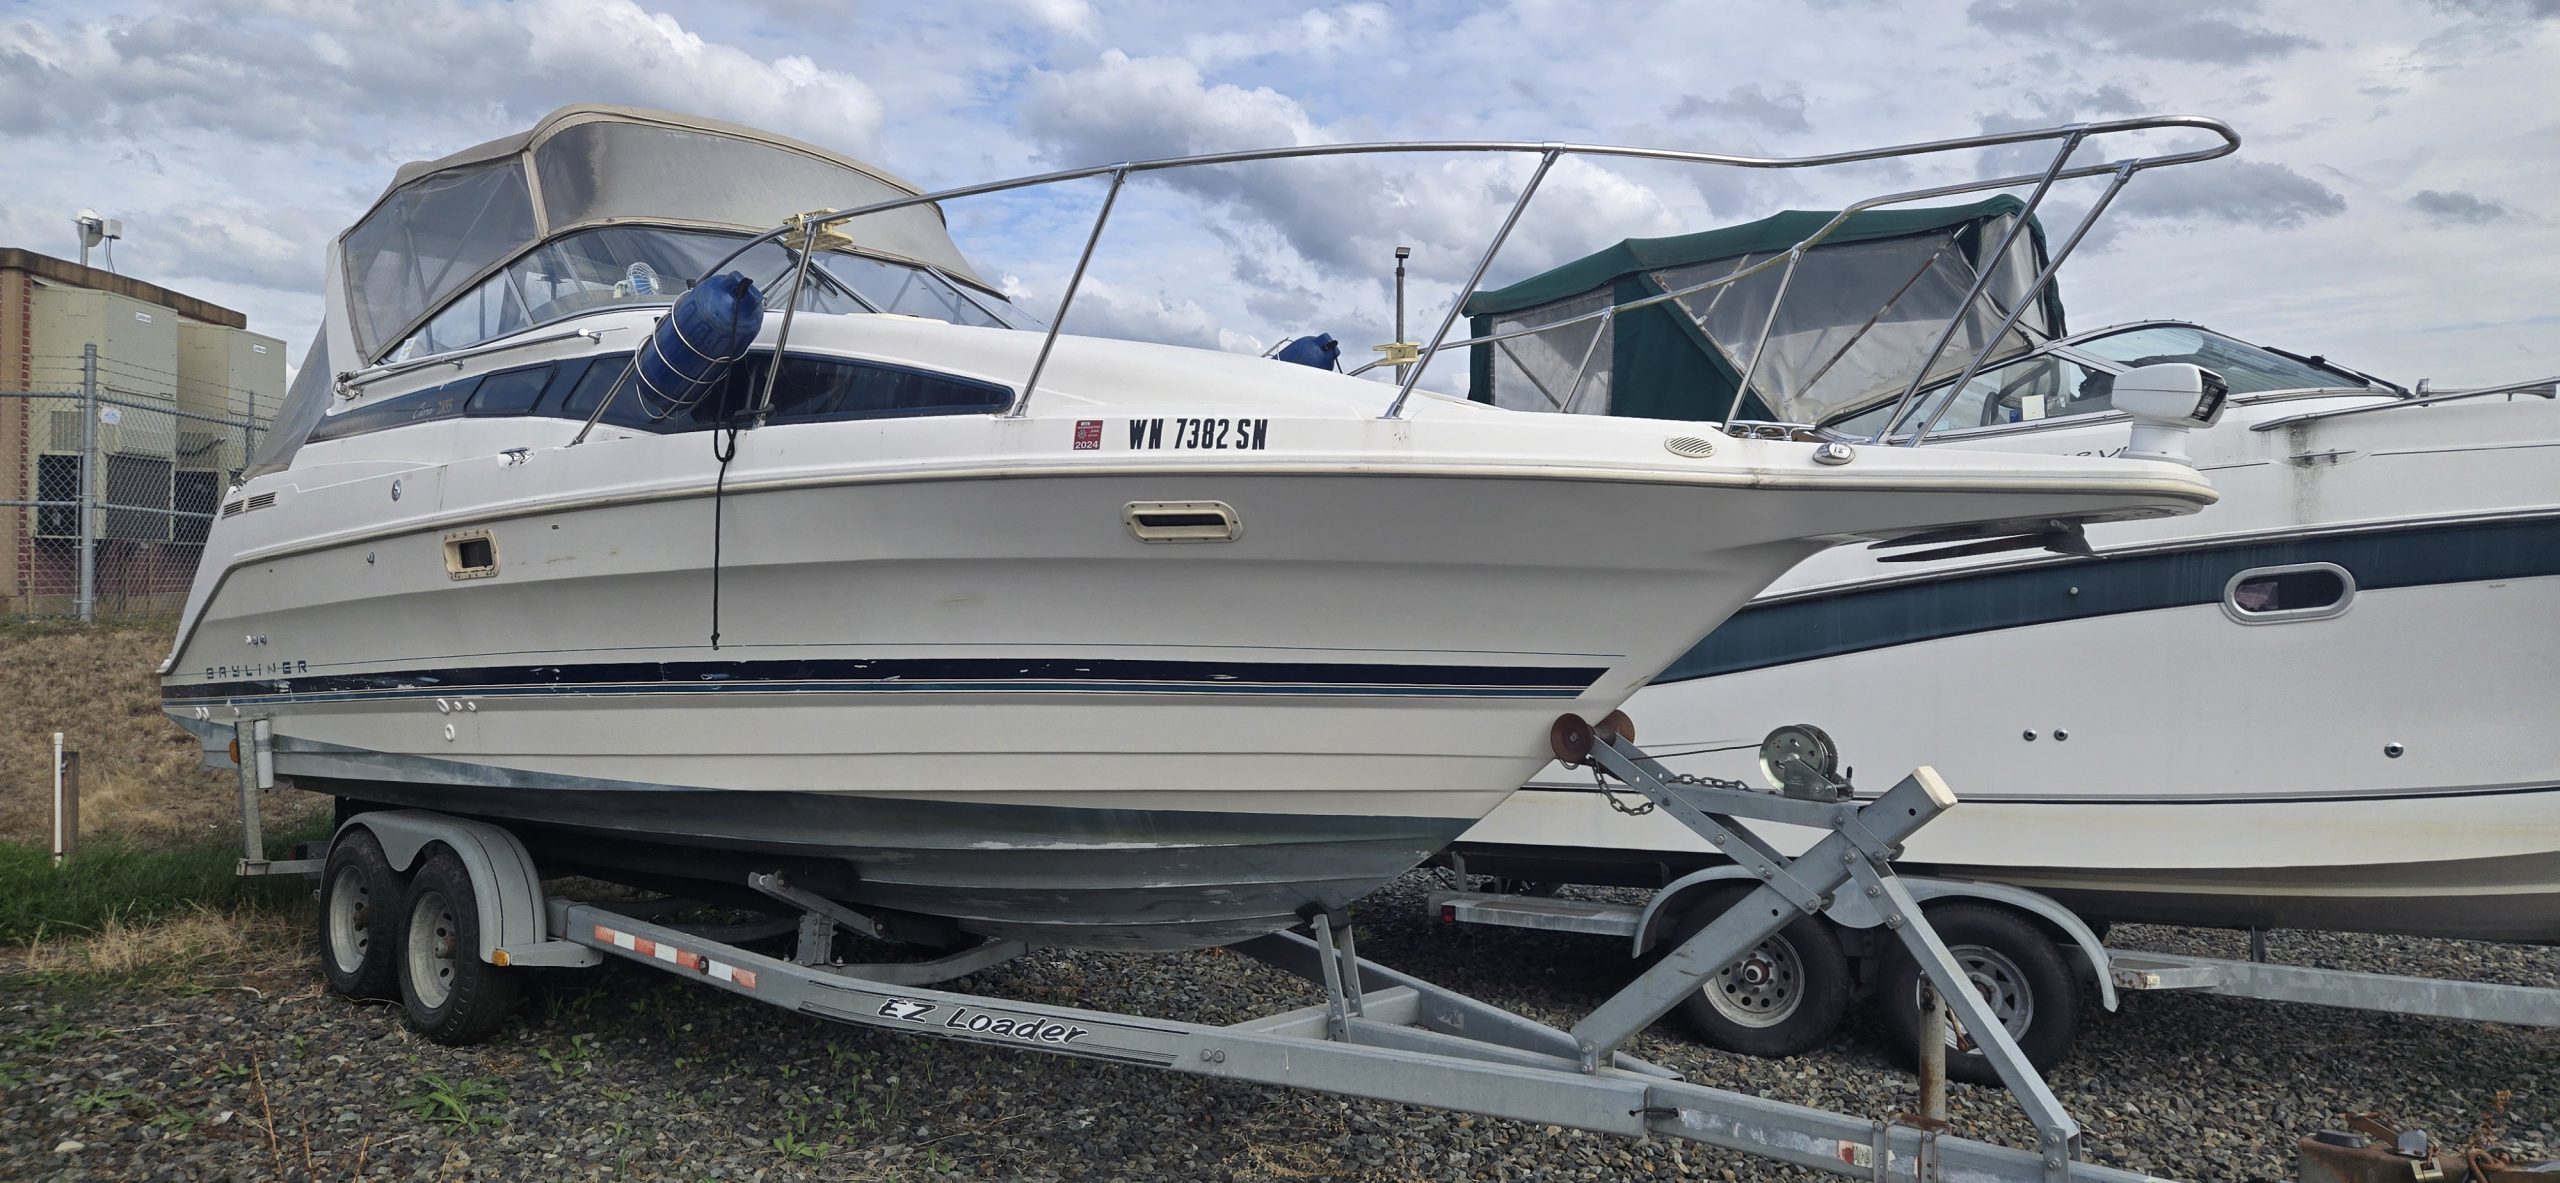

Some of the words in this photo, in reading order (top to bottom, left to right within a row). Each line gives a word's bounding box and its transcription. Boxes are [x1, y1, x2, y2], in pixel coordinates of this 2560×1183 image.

[1075, 440, 1099, 449] 2024
[1129, 418, 1164, 450] WN
[1174, 418, 1230, 450] 7382
[1236, 418, 1268, 450] SN
[206, 660, 308, 680] BAYLINER
[877, 998, 938, 1024] EZ
[945, 1007, 1089, 1045] Loader
